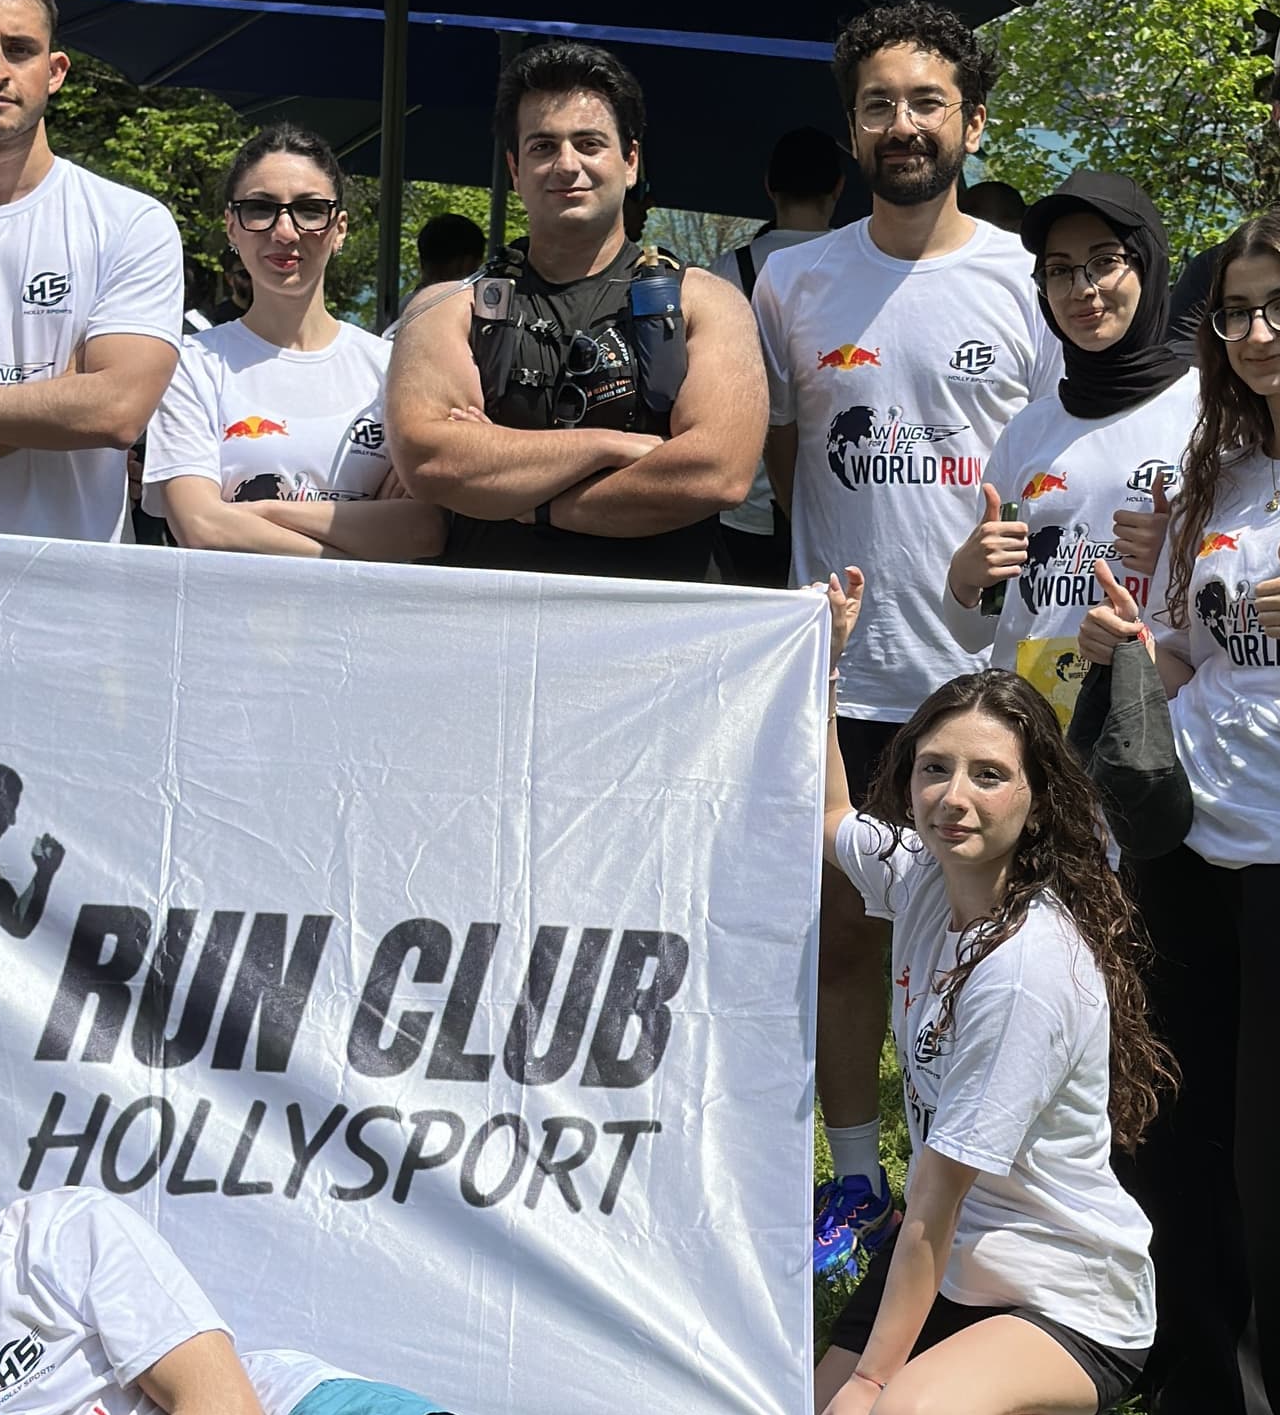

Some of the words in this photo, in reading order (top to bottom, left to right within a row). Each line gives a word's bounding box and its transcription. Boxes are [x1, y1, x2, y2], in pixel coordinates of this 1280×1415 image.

[871, 422, 935, 441] WINGS
[880, 441, 917, 455] LIFE
[1057, 541, 1119, 560] WINGS
[33, 902, 336, 1074] RUN
[345, 916, 690, 1090] CLUB
[17, 1089, 662, 1216] HOLLYSPORT
[23, 1363, 57, 1385] SPORTS
